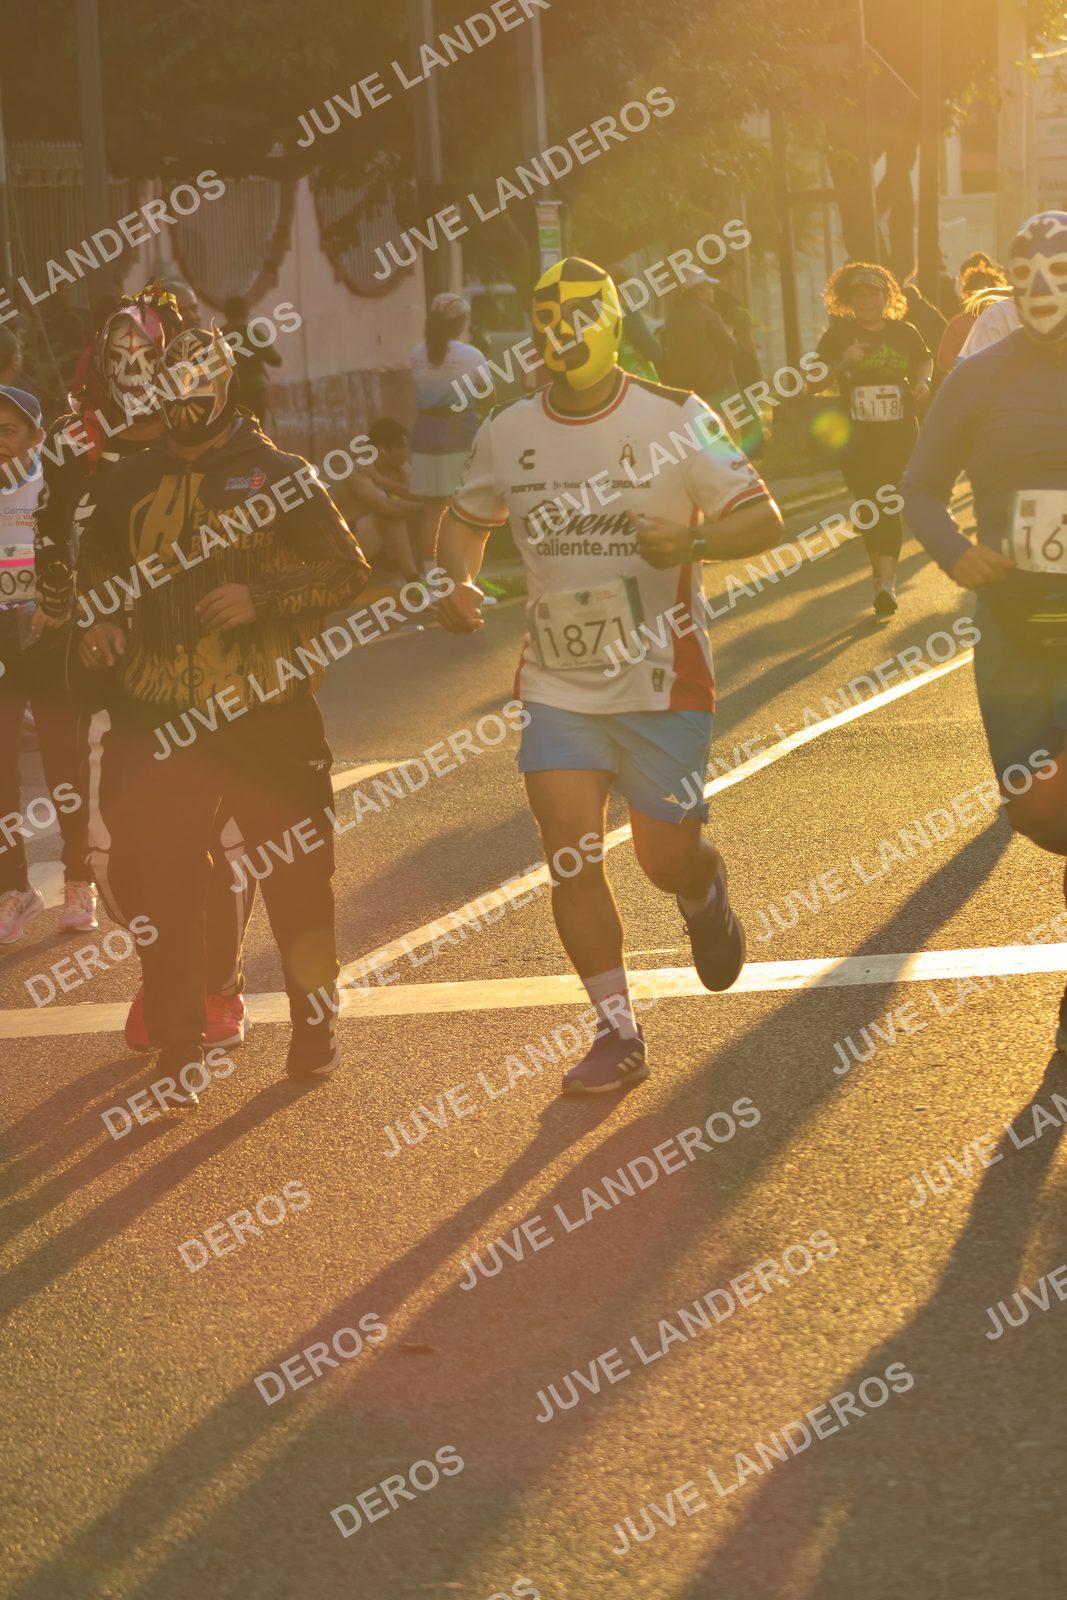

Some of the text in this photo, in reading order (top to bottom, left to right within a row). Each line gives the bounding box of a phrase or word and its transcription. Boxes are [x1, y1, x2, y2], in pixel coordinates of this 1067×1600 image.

[859, 400, 899, 417] 1118
[536, 538, 641, 557] caliente.mx
[1021, 525, 1065, 562] 16
[544, 616, 629, 658] 1871
